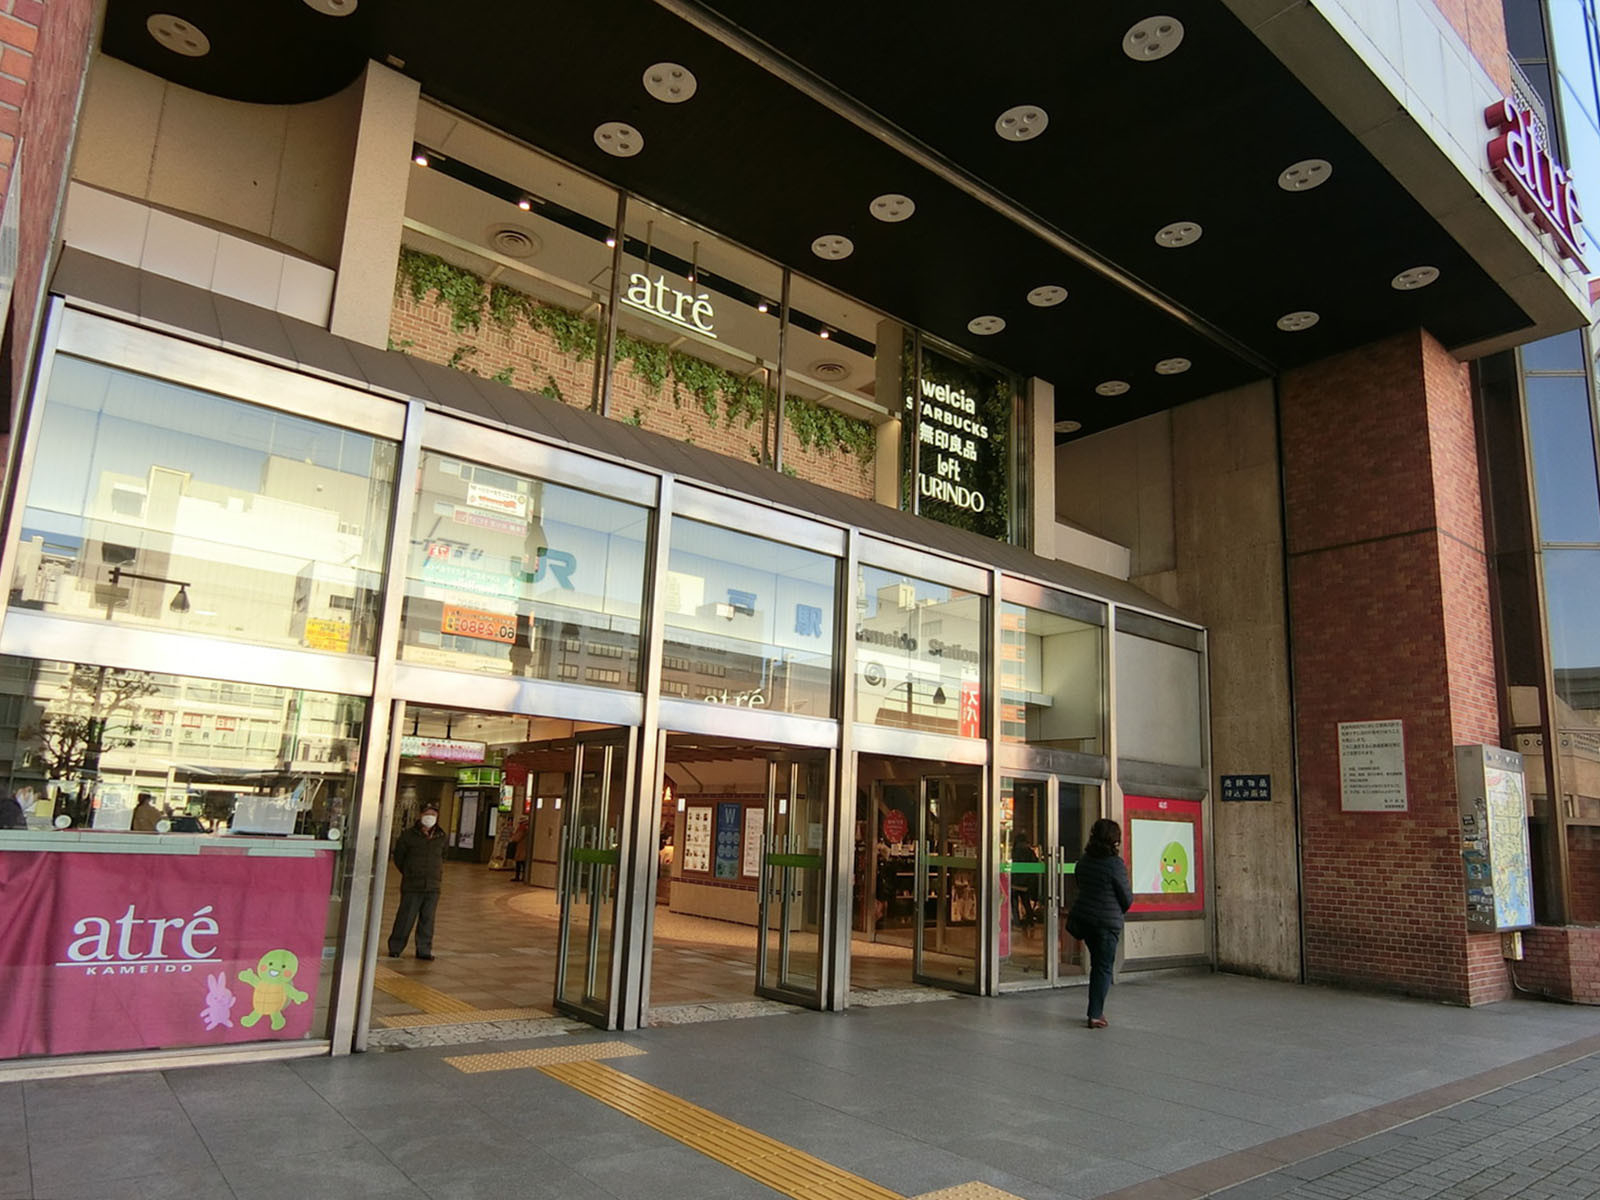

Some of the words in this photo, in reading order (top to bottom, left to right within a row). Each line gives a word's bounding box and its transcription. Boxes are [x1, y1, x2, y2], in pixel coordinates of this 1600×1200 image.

[627, 272, 715, 332] atré
[921, 379, 975, 415] welcia
[919, 421, 978, 462] 無印良品
[918, 472, 985, 513] URINDO
[66, 904, 220, 962] atré
[85, 963, 194, 976] KAMEIDO
